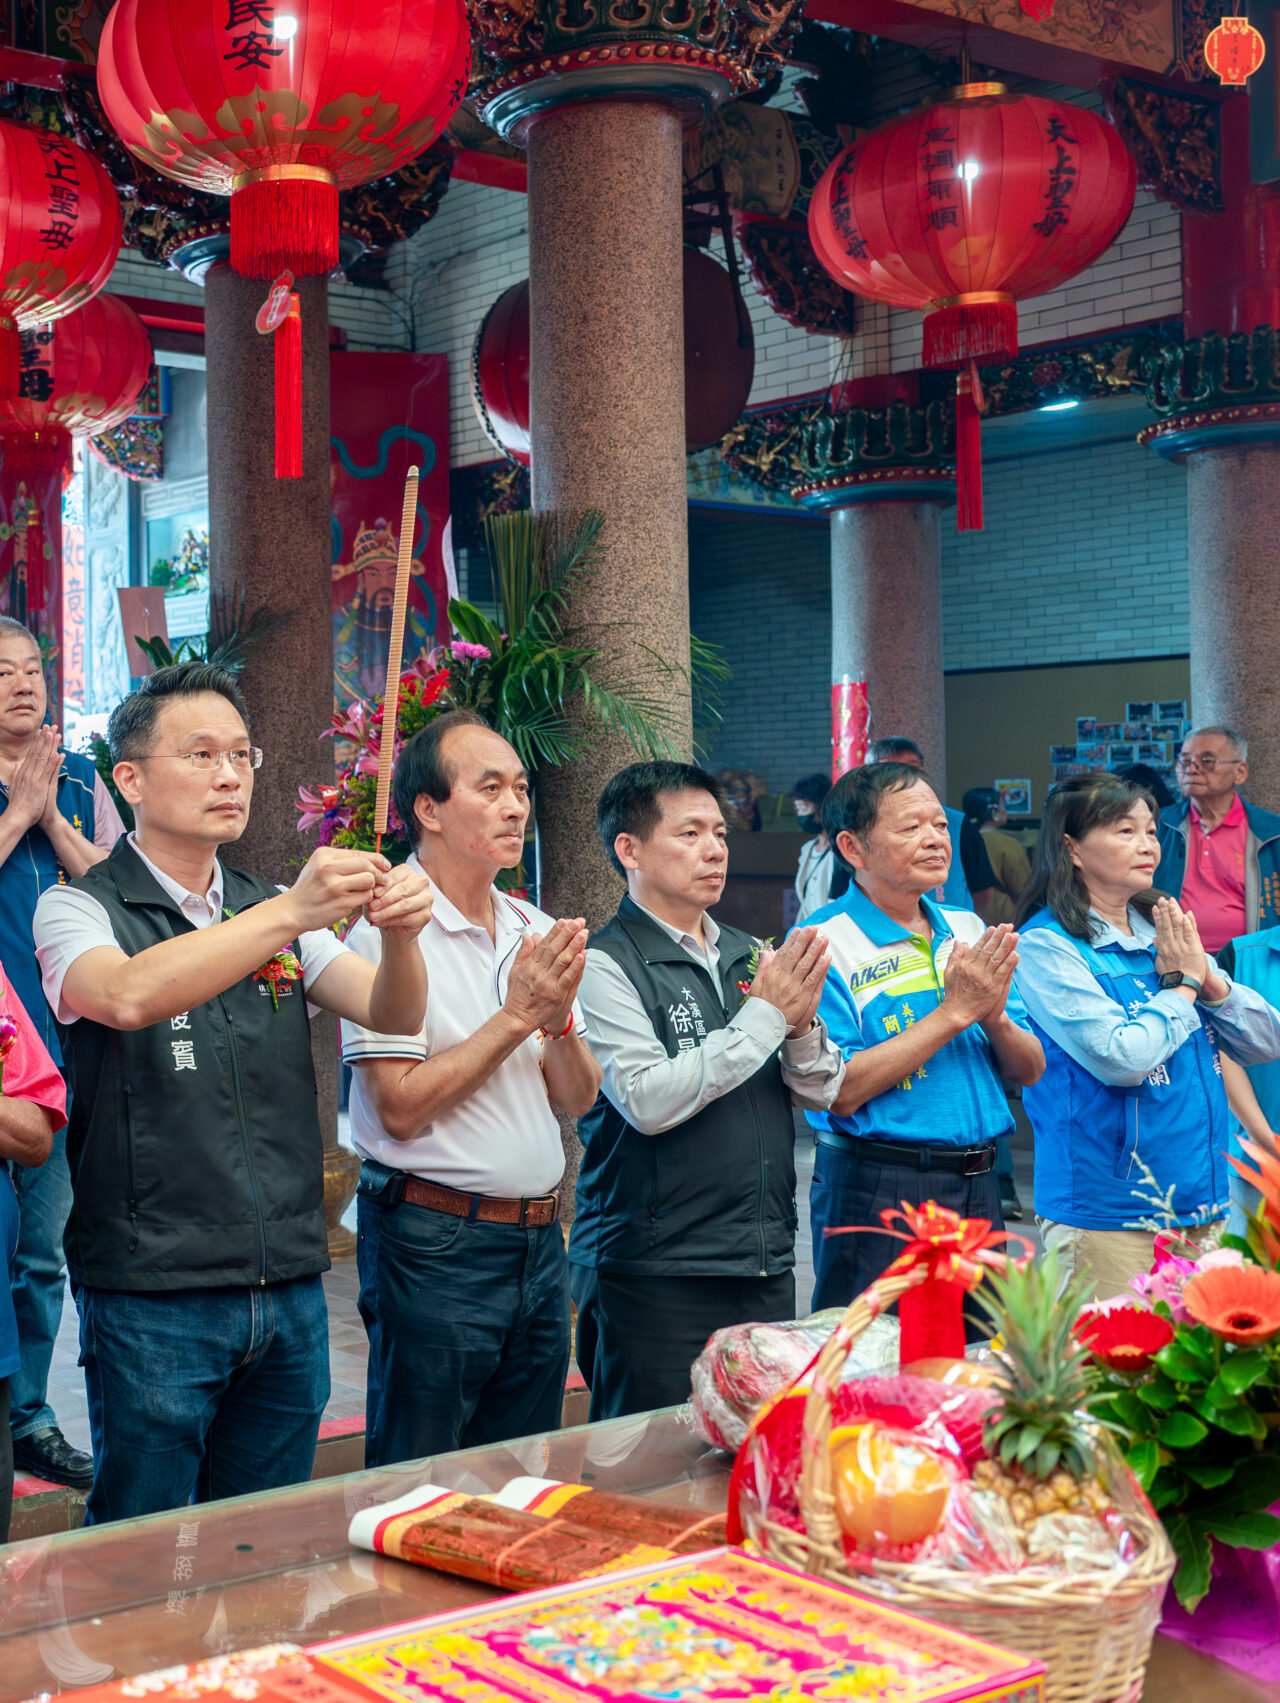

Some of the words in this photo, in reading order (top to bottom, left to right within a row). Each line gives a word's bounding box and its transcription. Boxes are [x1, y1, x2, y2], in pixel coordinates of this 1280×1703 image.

[35, 136, 81, 250] 天上聖母
[1032, 117, 1079, 238] 天上聖母
[681, 986, 708, 1047] 大溪區
